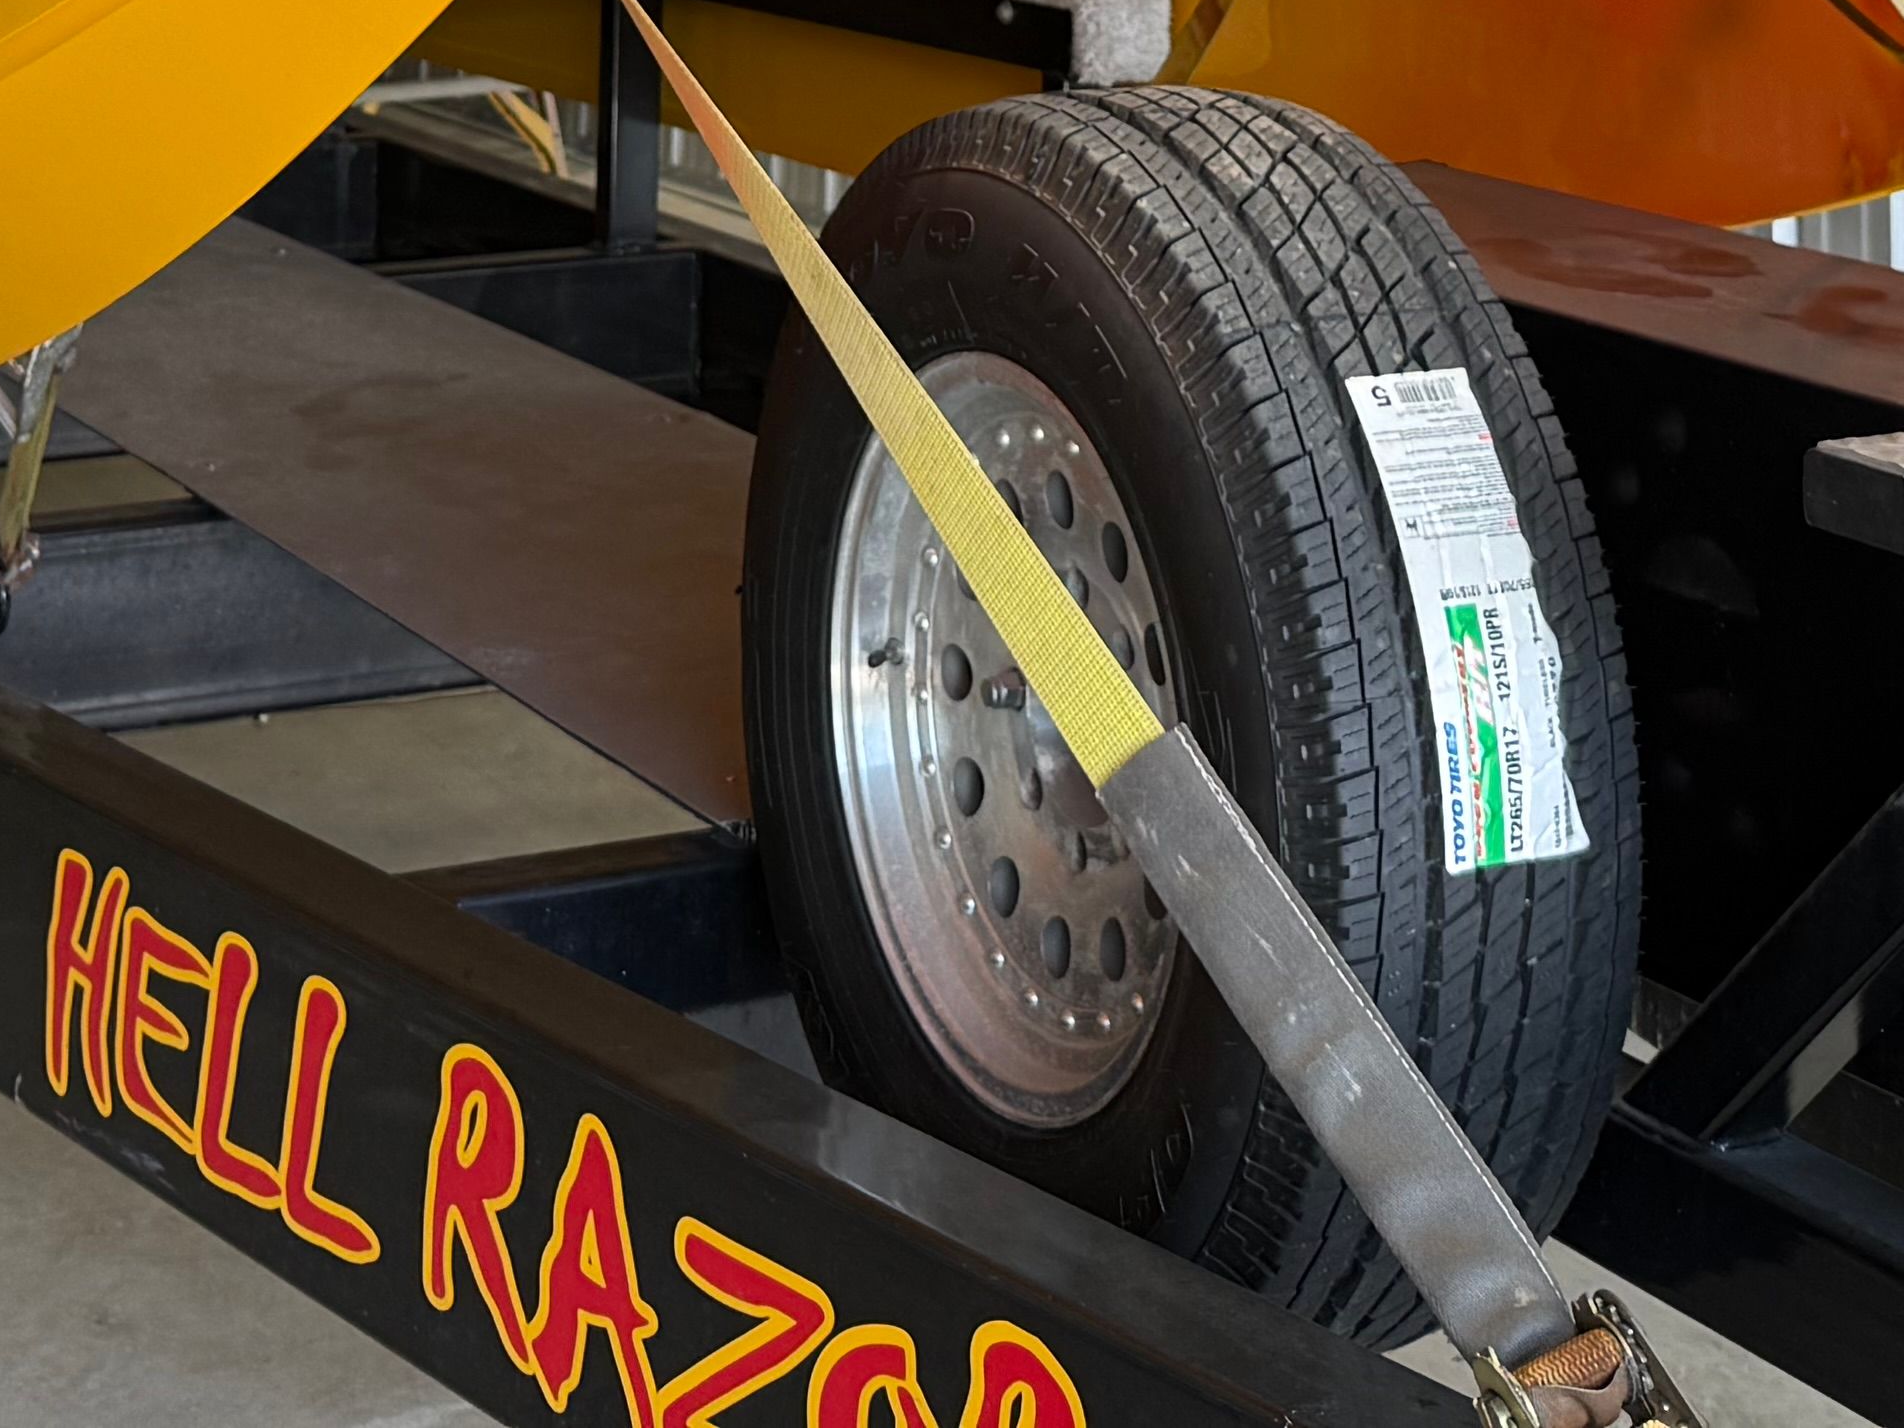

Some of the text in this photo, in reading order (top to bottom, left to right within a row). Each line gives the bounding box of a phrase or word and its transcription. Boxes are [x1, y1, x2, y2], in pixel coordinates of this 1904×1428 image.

[1371, 385, 1392, 407] 5
[1443, 721, 1466, 864] TOYO TIRES
[1483, 607, 1524, 853] LT265/70R17 121S/10PR
[45, 848, 380, 1263] HELL
